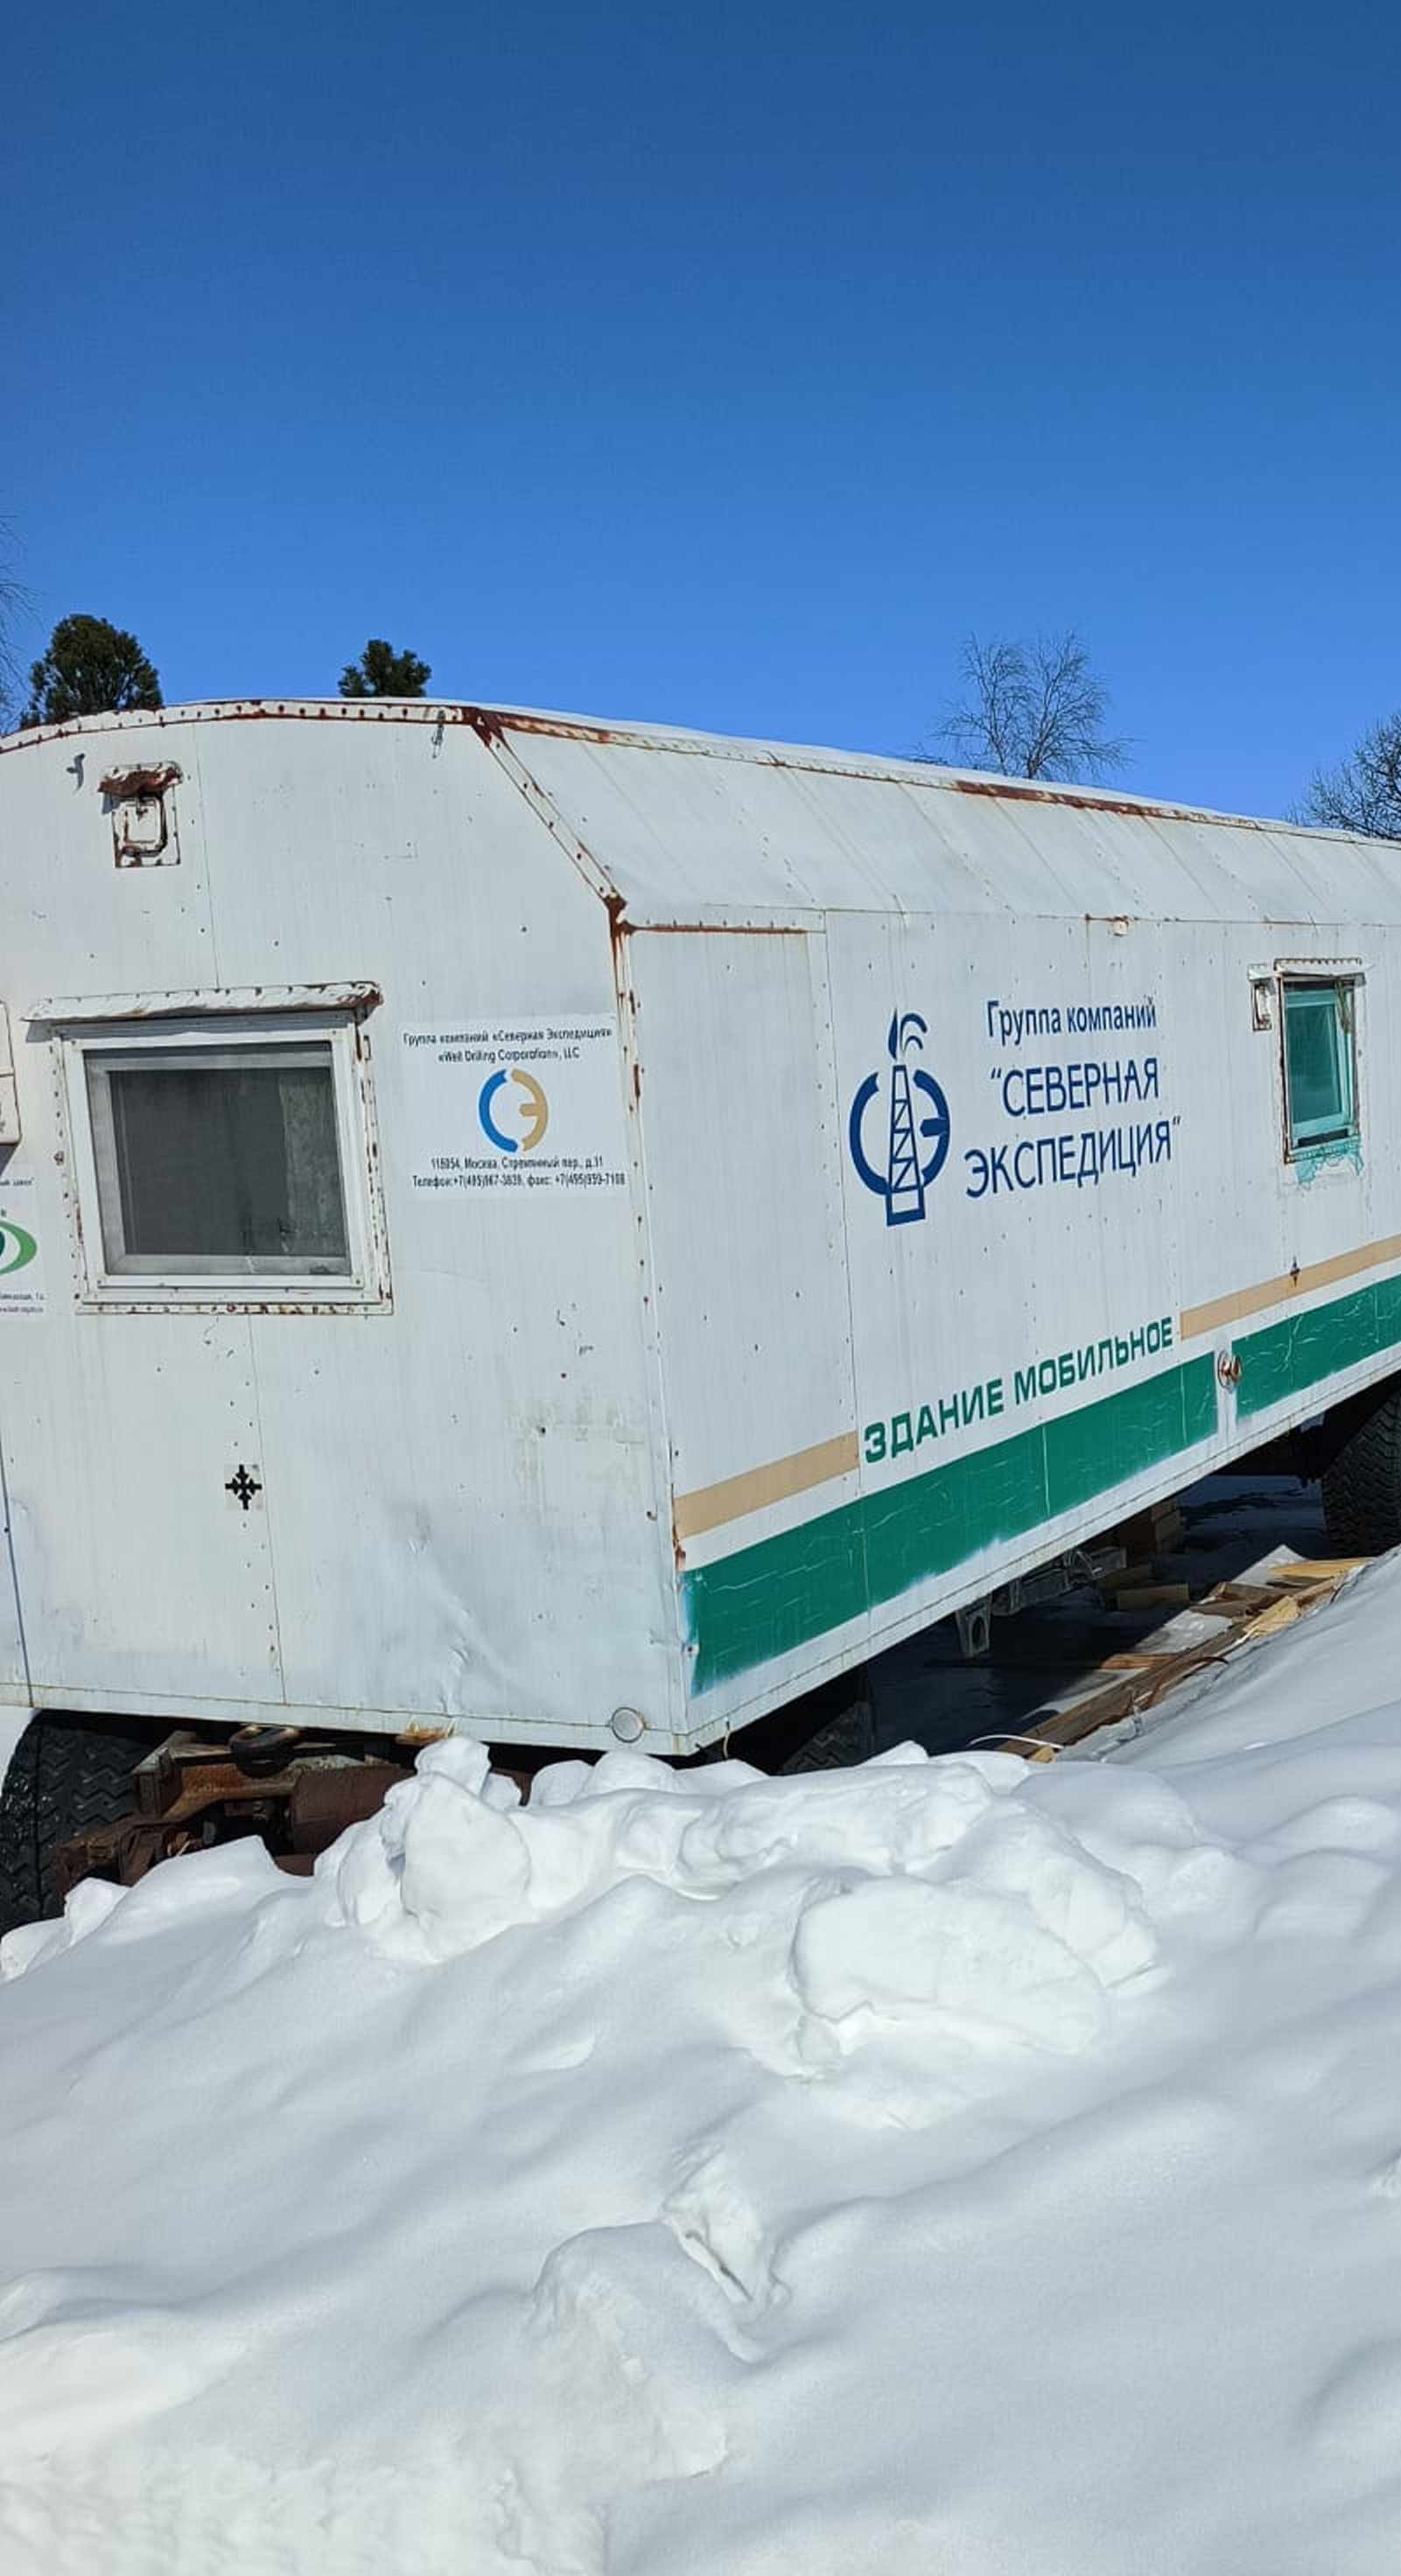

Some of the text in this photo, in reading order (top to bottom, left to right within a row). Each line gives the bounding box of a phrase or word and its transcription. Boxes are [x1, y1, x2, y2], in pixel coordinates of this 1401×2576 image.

[403, 1032, 436, 1046] Группа
[439, 1030, 488, 1043] компаний
[986, 996, 1157, 1047] Группа компаний
[863, 1316, 1173, 1464] ЗДАНИЕ МОБИЛЬНОЕ
